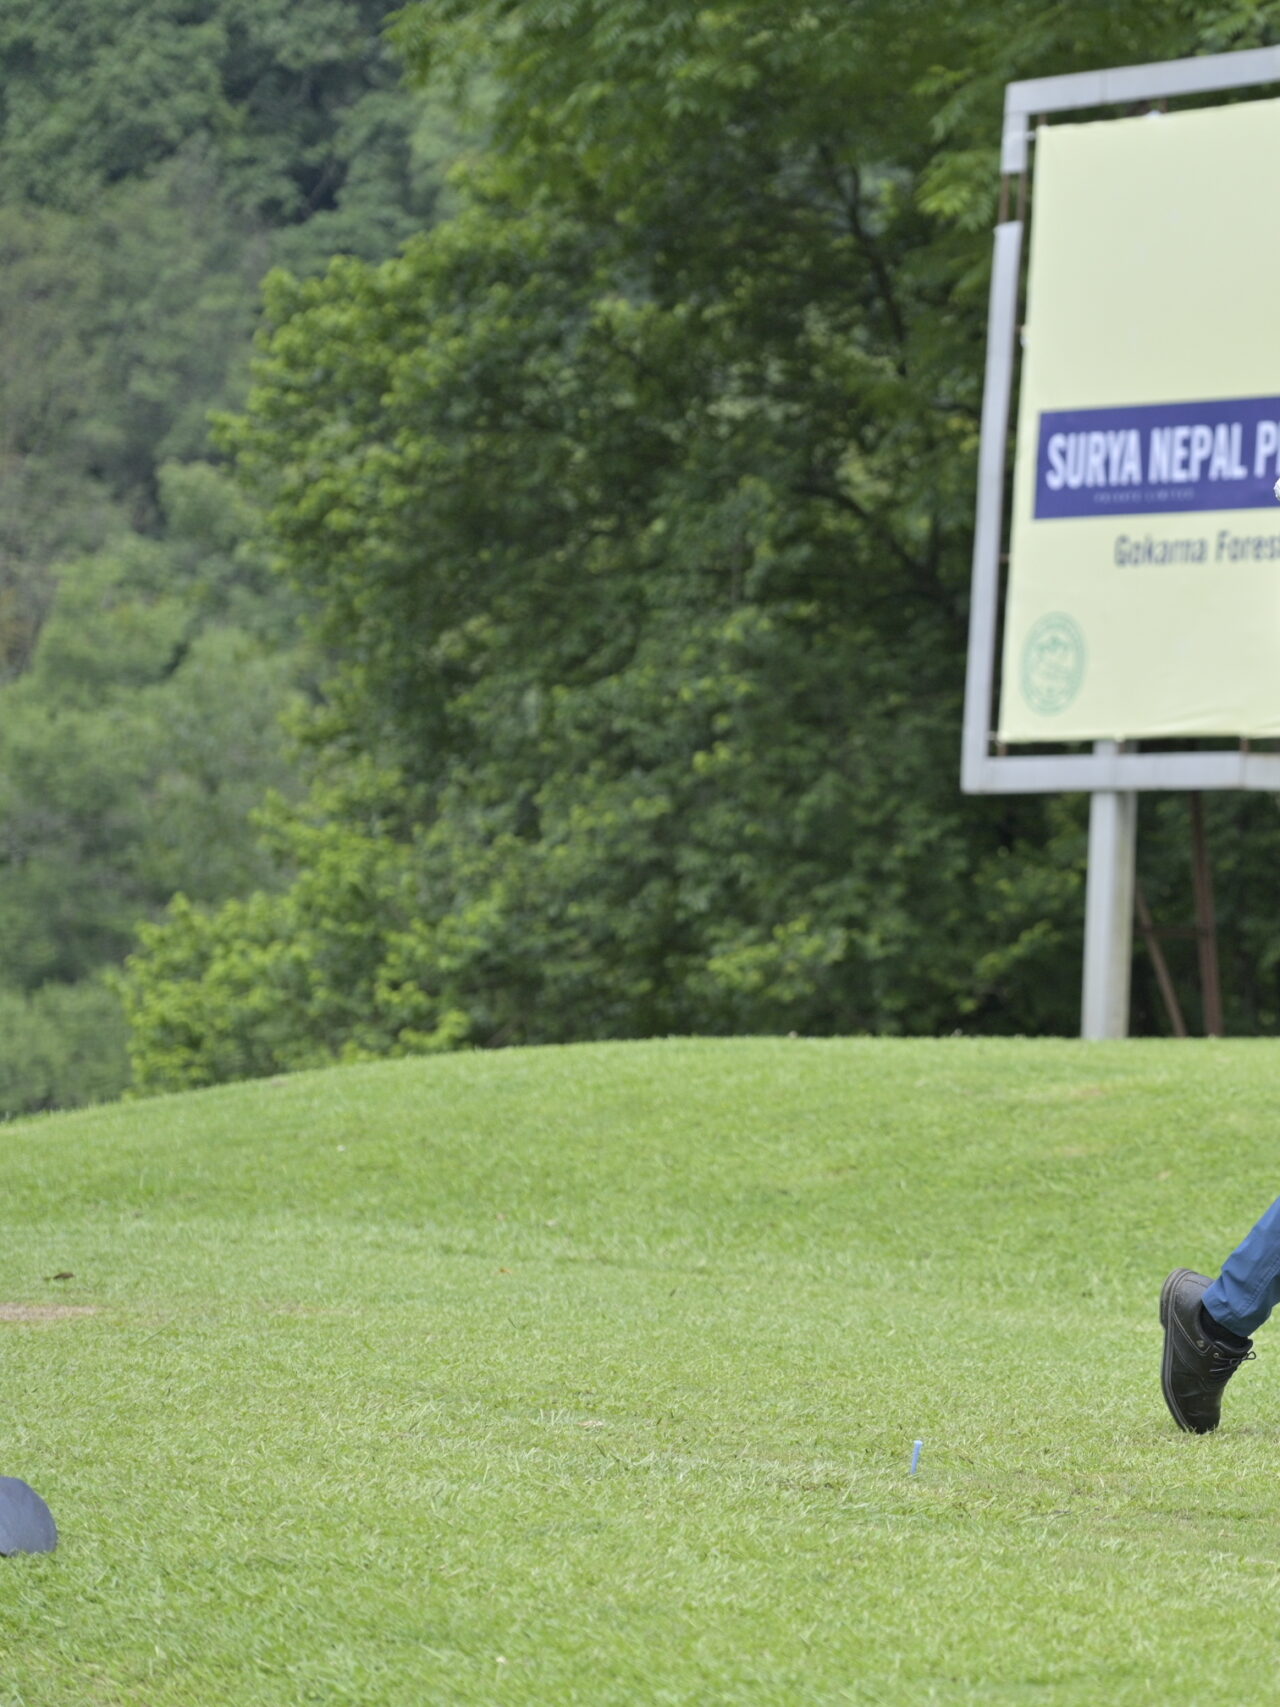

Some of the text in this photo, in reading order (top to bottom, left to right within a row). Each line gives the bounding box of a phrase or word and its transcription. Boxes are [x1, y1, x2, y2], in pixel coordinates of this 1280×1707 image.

[1045, 429, 1142, 490] SURYA
[1148, 422, 1248, 484] NEPAL
[1114, 532, 1209, 567] Gokarna
